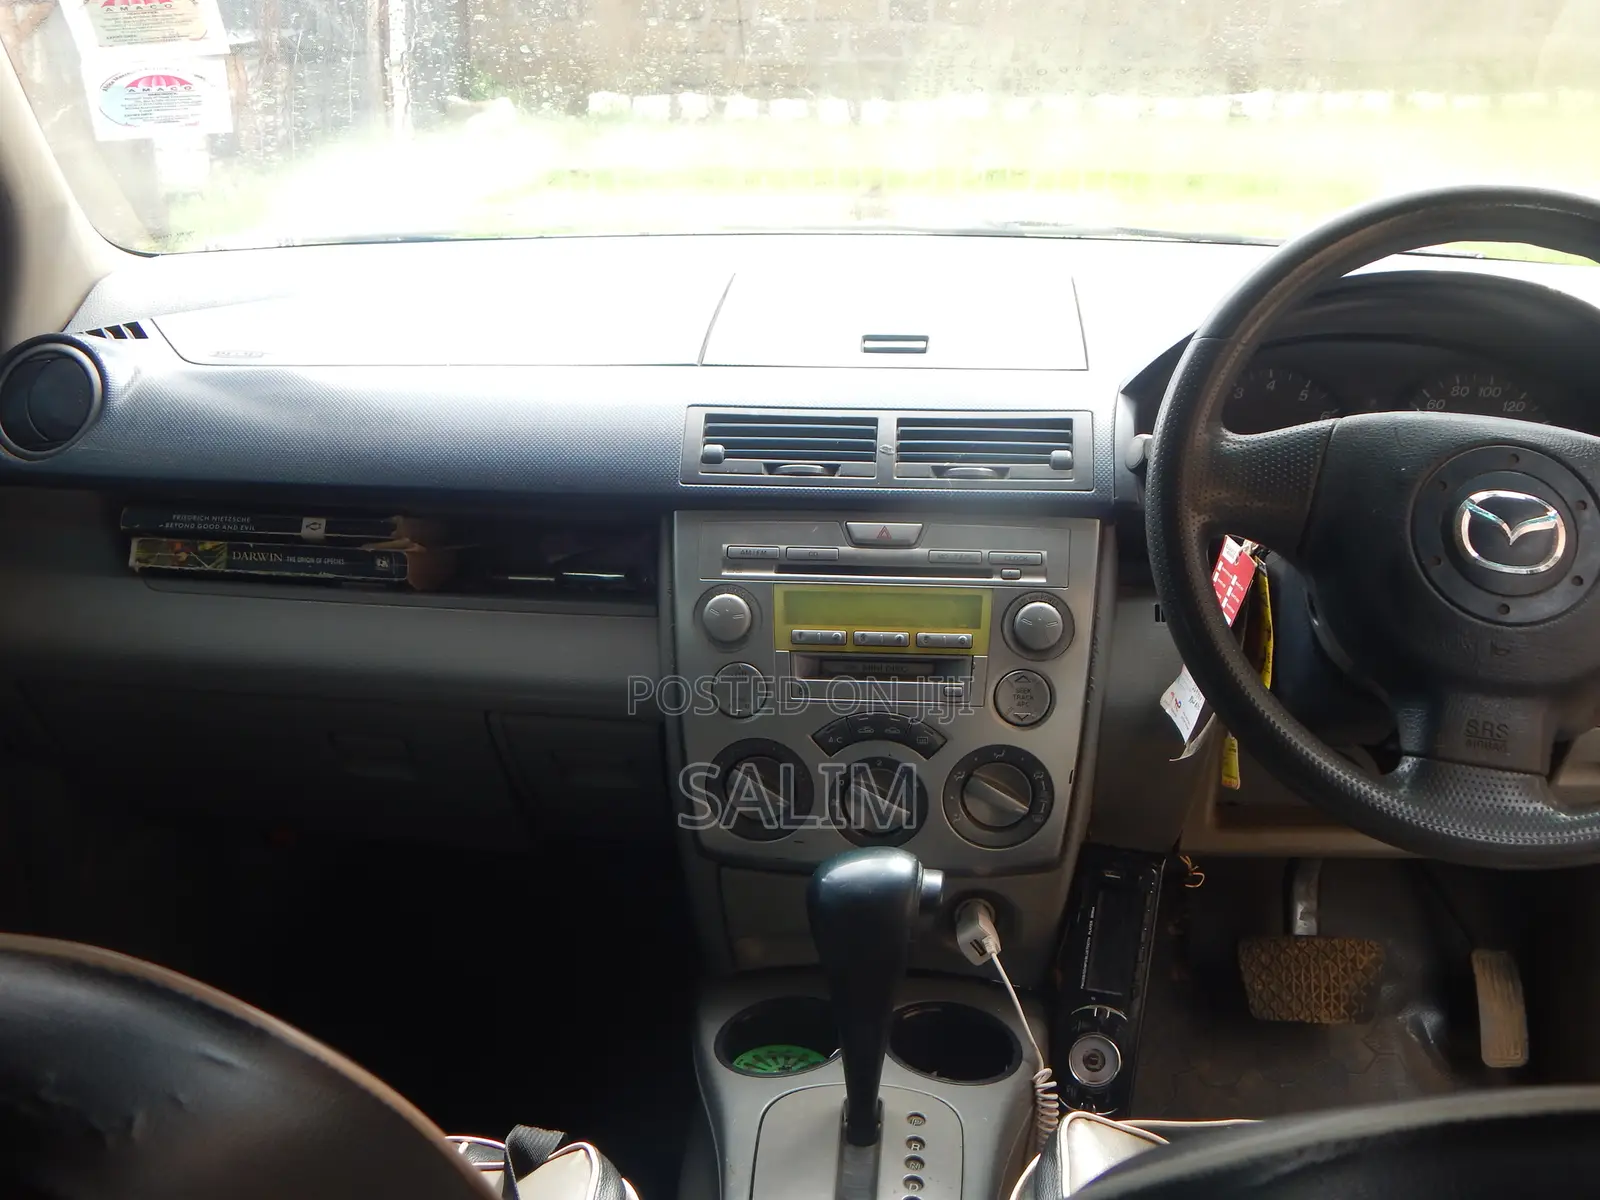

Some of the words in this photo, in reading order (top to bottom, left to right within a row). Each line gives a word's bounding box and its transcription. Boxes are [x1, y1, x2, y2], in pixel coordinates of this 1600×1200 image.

[105, 3, 173, 12] AMACO
[128, 85, 192, 93] AMACO
[1266, 379, 1277, 391] 4
[1233, 387, 1245, 400] 3
[1298, 389, 1309, 401] 5
[1451, 385, 1470, 398] 80
[1478, 386, 1502, 398] 100
[1426, 399, 1446, 410] 60
[1503, 400, 1526, 412] 120
[172, 513, 210, 522] FRIEDRICH
[211, 515, 251, 523] NIETZSCHE
[165, 522, 195, 530] BEYOND
[232, 550, 284, 562] DARWIN
[1465, 718, 1510, 739] SRS
[908, 1183, 919, 1192] D
